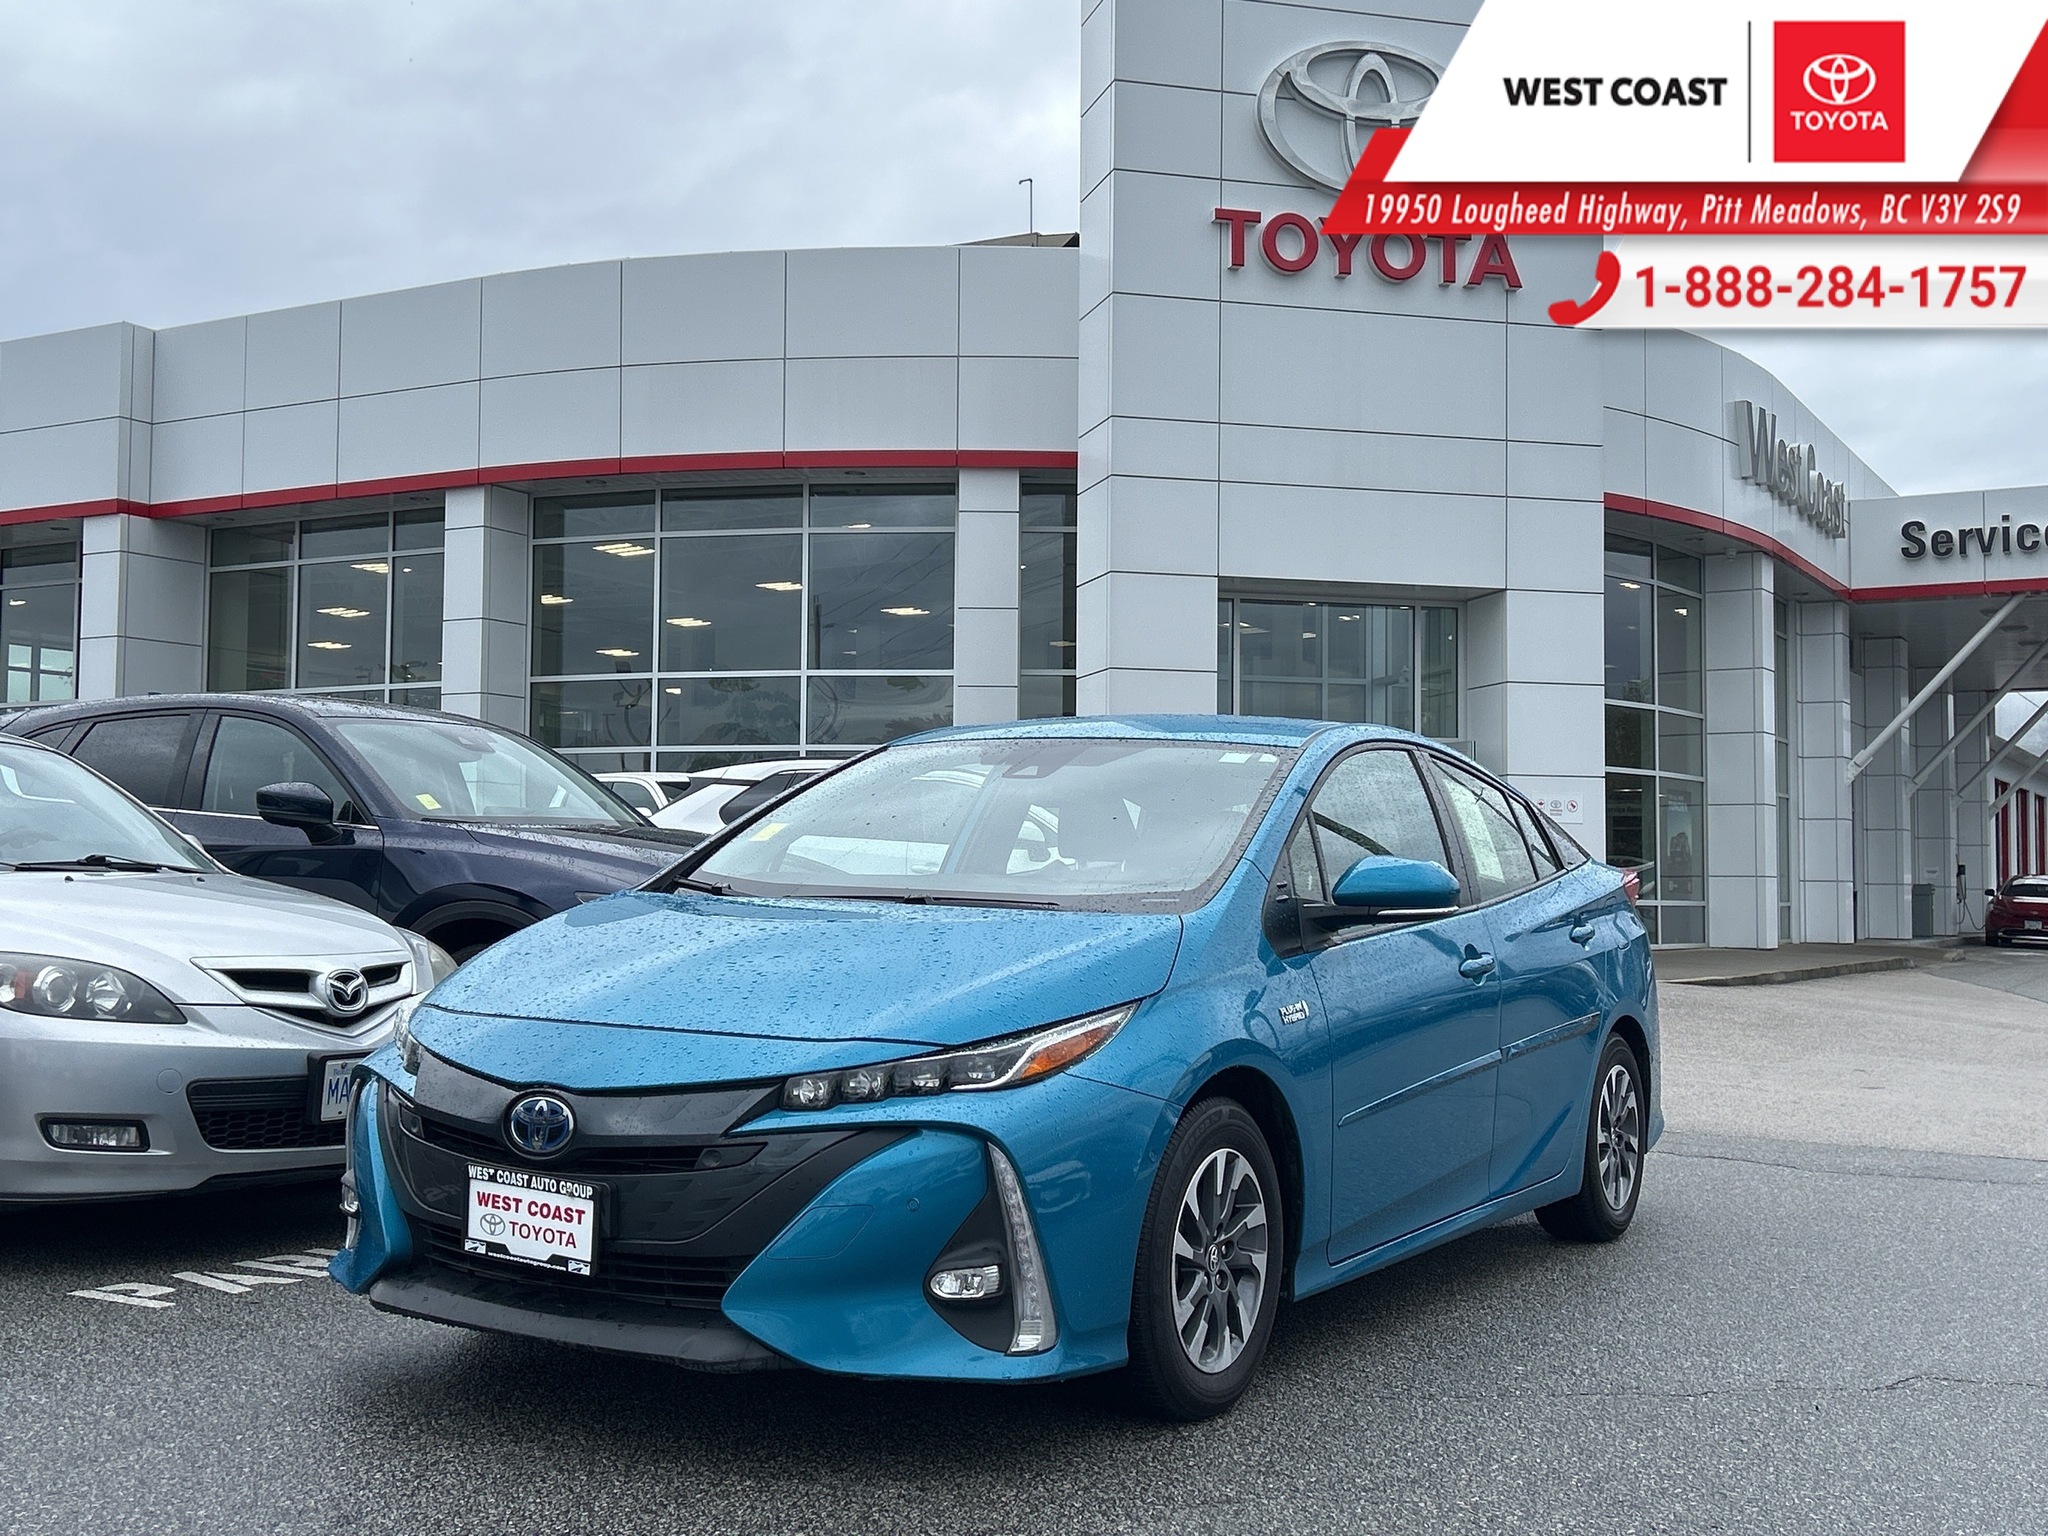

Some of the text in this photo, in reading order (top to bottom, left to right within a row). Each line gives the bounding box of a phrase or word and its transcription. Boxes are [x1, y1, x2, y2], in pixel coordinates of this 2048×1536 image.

[1213, 207, 1524, 291] TOYOTA
[1735, 399, 1846, 539] West Coast
[1900, 512, 2048, 562] Servic
[1282, 1010, 1306, 1025] HYBRID
[327, 1076, 351, 1105] MA
[496, 1170, 530, 1188] COAST
[530, 1176, 557, 1193] AUTO
[477, 1190, 586, 1225] WEST COAST
[509, 1221, 577, 1248] TOYOTA
[66, 1248, 342, 1308] PAR
